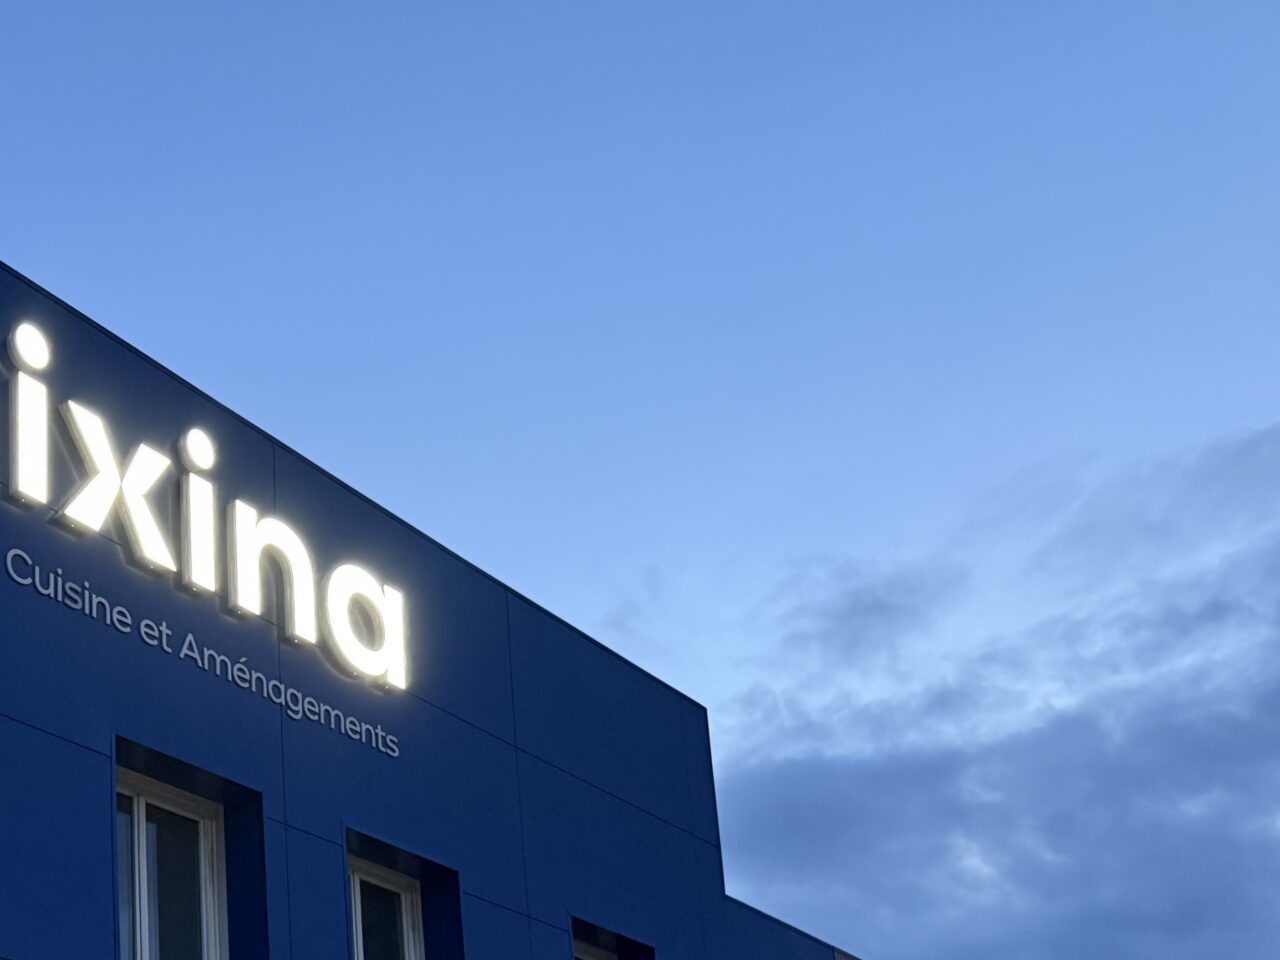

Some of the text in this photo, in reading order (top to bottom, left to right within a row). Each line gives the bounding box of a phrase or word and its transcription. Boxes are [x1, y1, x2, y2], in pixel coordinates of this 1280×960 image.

[8, 322, 407, 690] ixina
[6, 548, 400, 757] Cuisine et Aménagements
